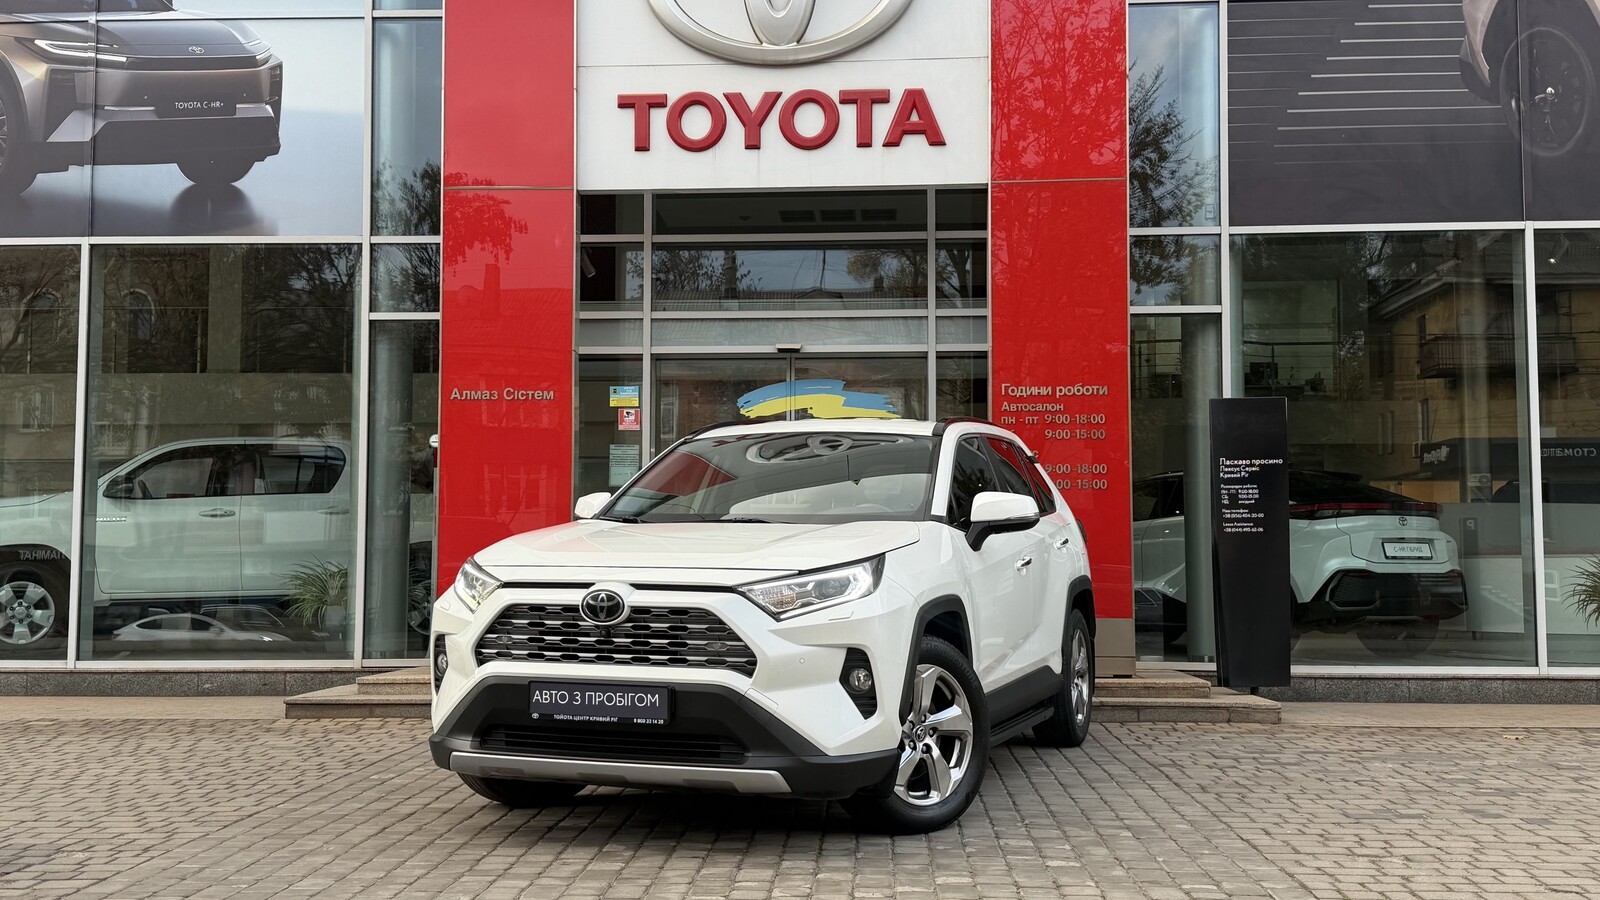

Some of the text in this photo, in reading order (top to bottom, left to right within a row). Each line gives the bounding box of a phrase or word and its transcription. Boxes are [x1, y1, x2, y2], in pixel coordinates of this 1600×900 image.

[175, 101, 201, 109] TOYOTA
[617, 88, 946, 152] TOYOTA
[450, 387, 554, 400] Алмаз Сістем
[1001, 383, 1108, 398] Години роботи
[1001, 401, 1064, 412] Автосалон
[1001, 416, 1016, 424] пн
[1025, 416, 1039, 424] пт
[1220, 457, 1250, 465] Ласкаво
[1053, 479, 1108, 489] :00-15:00
[532, 690, 569, 704] АВТО
[585, 691, 659, 707] ПРОБІГОМ
